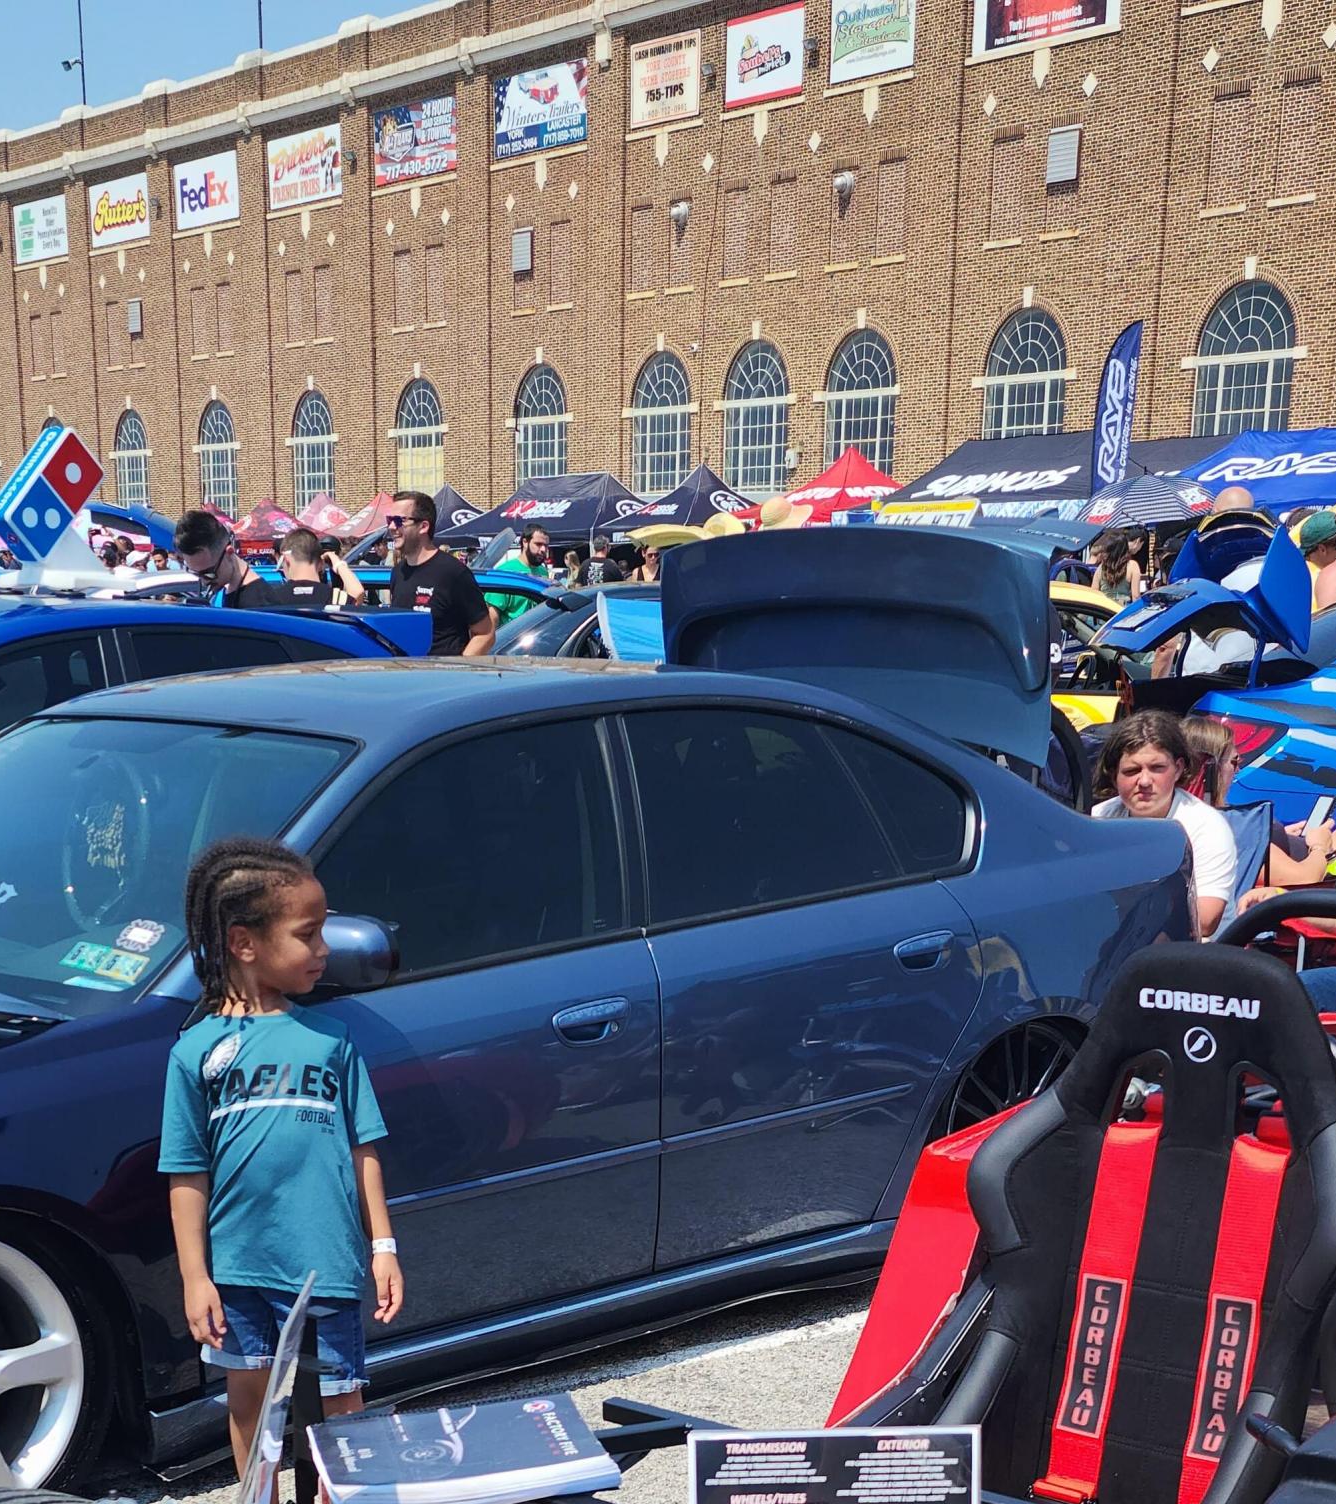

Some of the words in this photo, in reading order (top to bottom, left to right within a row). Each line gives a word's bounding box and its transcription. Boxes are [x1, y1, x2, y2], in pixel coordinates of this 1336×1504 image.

[1052, 5, 1083, 20] Frederick
[634, 49, 648, 61] CASH
[649, 45, 672, 58] REWARD
[673, 42, 683, 53] FOR
[685, 37, 696, 50] TIPS
[645, 82, 684, 103] 755-TIPS
[432, 99, 453, 117] HOUR
[504, 104, 547, 129] Winters
[549, 101, 580, 119] Trailers
[507, 128, 524, 140] YORK
[547, 115, 582, 131] LANCASTER
[179, 171, 228, 214] FedEx
[273, 182, 298, 202] FRENCH
[301, 177, 321, 196] FRIES
[94, 189, 146, 236] Rutter's
[1098, 358, 1125, 484] RAYS
[1119, 415, 1131, 468] concept
[845, 486, 900, 498] MOTU
[1139, 987, 1261, 1020] CORBEAU
[1070, 1285, 1112, 1427] CORBEAU
[1201, 1306, 1242, 1453] CORBEAU
[541, 1411, 569, 1443] FACTORY
[556, 1441, 579, 1456] FIVE
[877, 1438, 930, 1451] EXTERIOR
[726, 1441, 807, 1454] TRANSMISSION
[730, 1492, 807, 1504] WHEELS/TIRES
